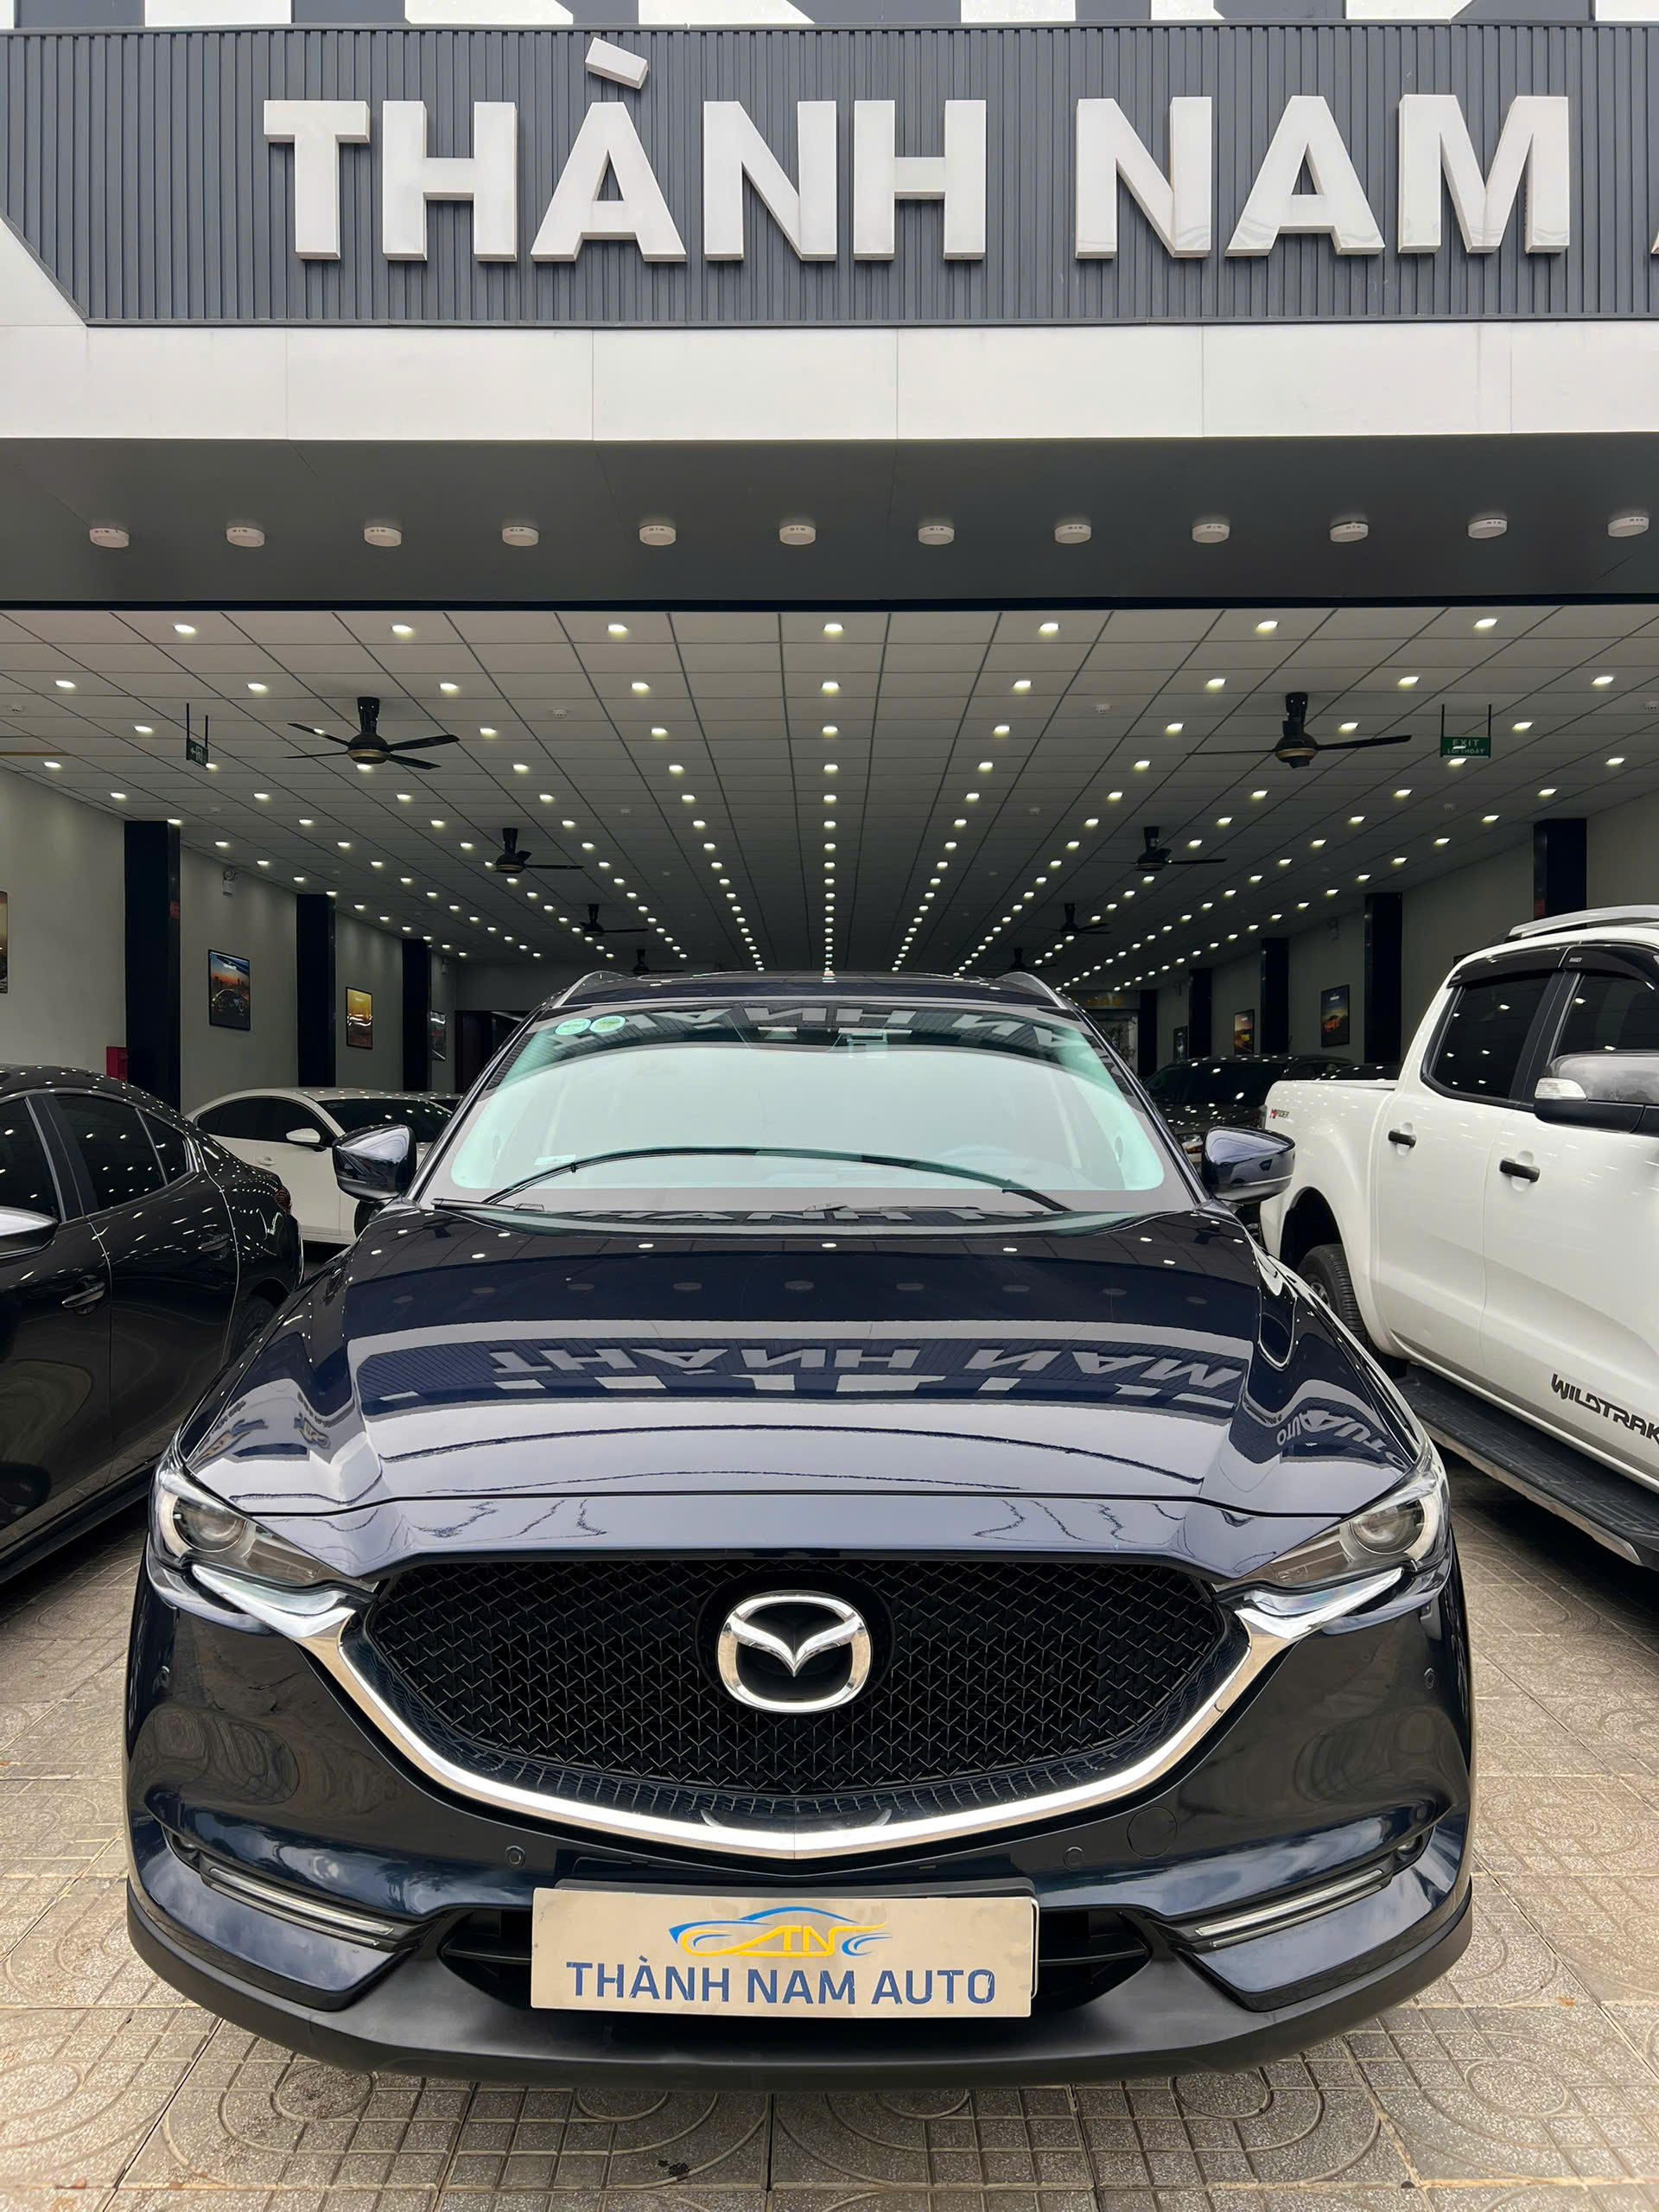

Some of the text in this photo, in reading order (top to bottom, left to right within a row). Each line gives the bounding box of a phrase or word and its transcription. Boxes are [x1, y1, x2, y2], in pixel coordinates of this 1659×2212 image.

[263, 36, 1570, 261] THÀNH NAM
[1452, 739, 1479, 747] EXIT
[1551, 1373, 1659, 1445] WILDTRAK
[566, 1955, 995, 2005] THÀNH NAM AUTO
